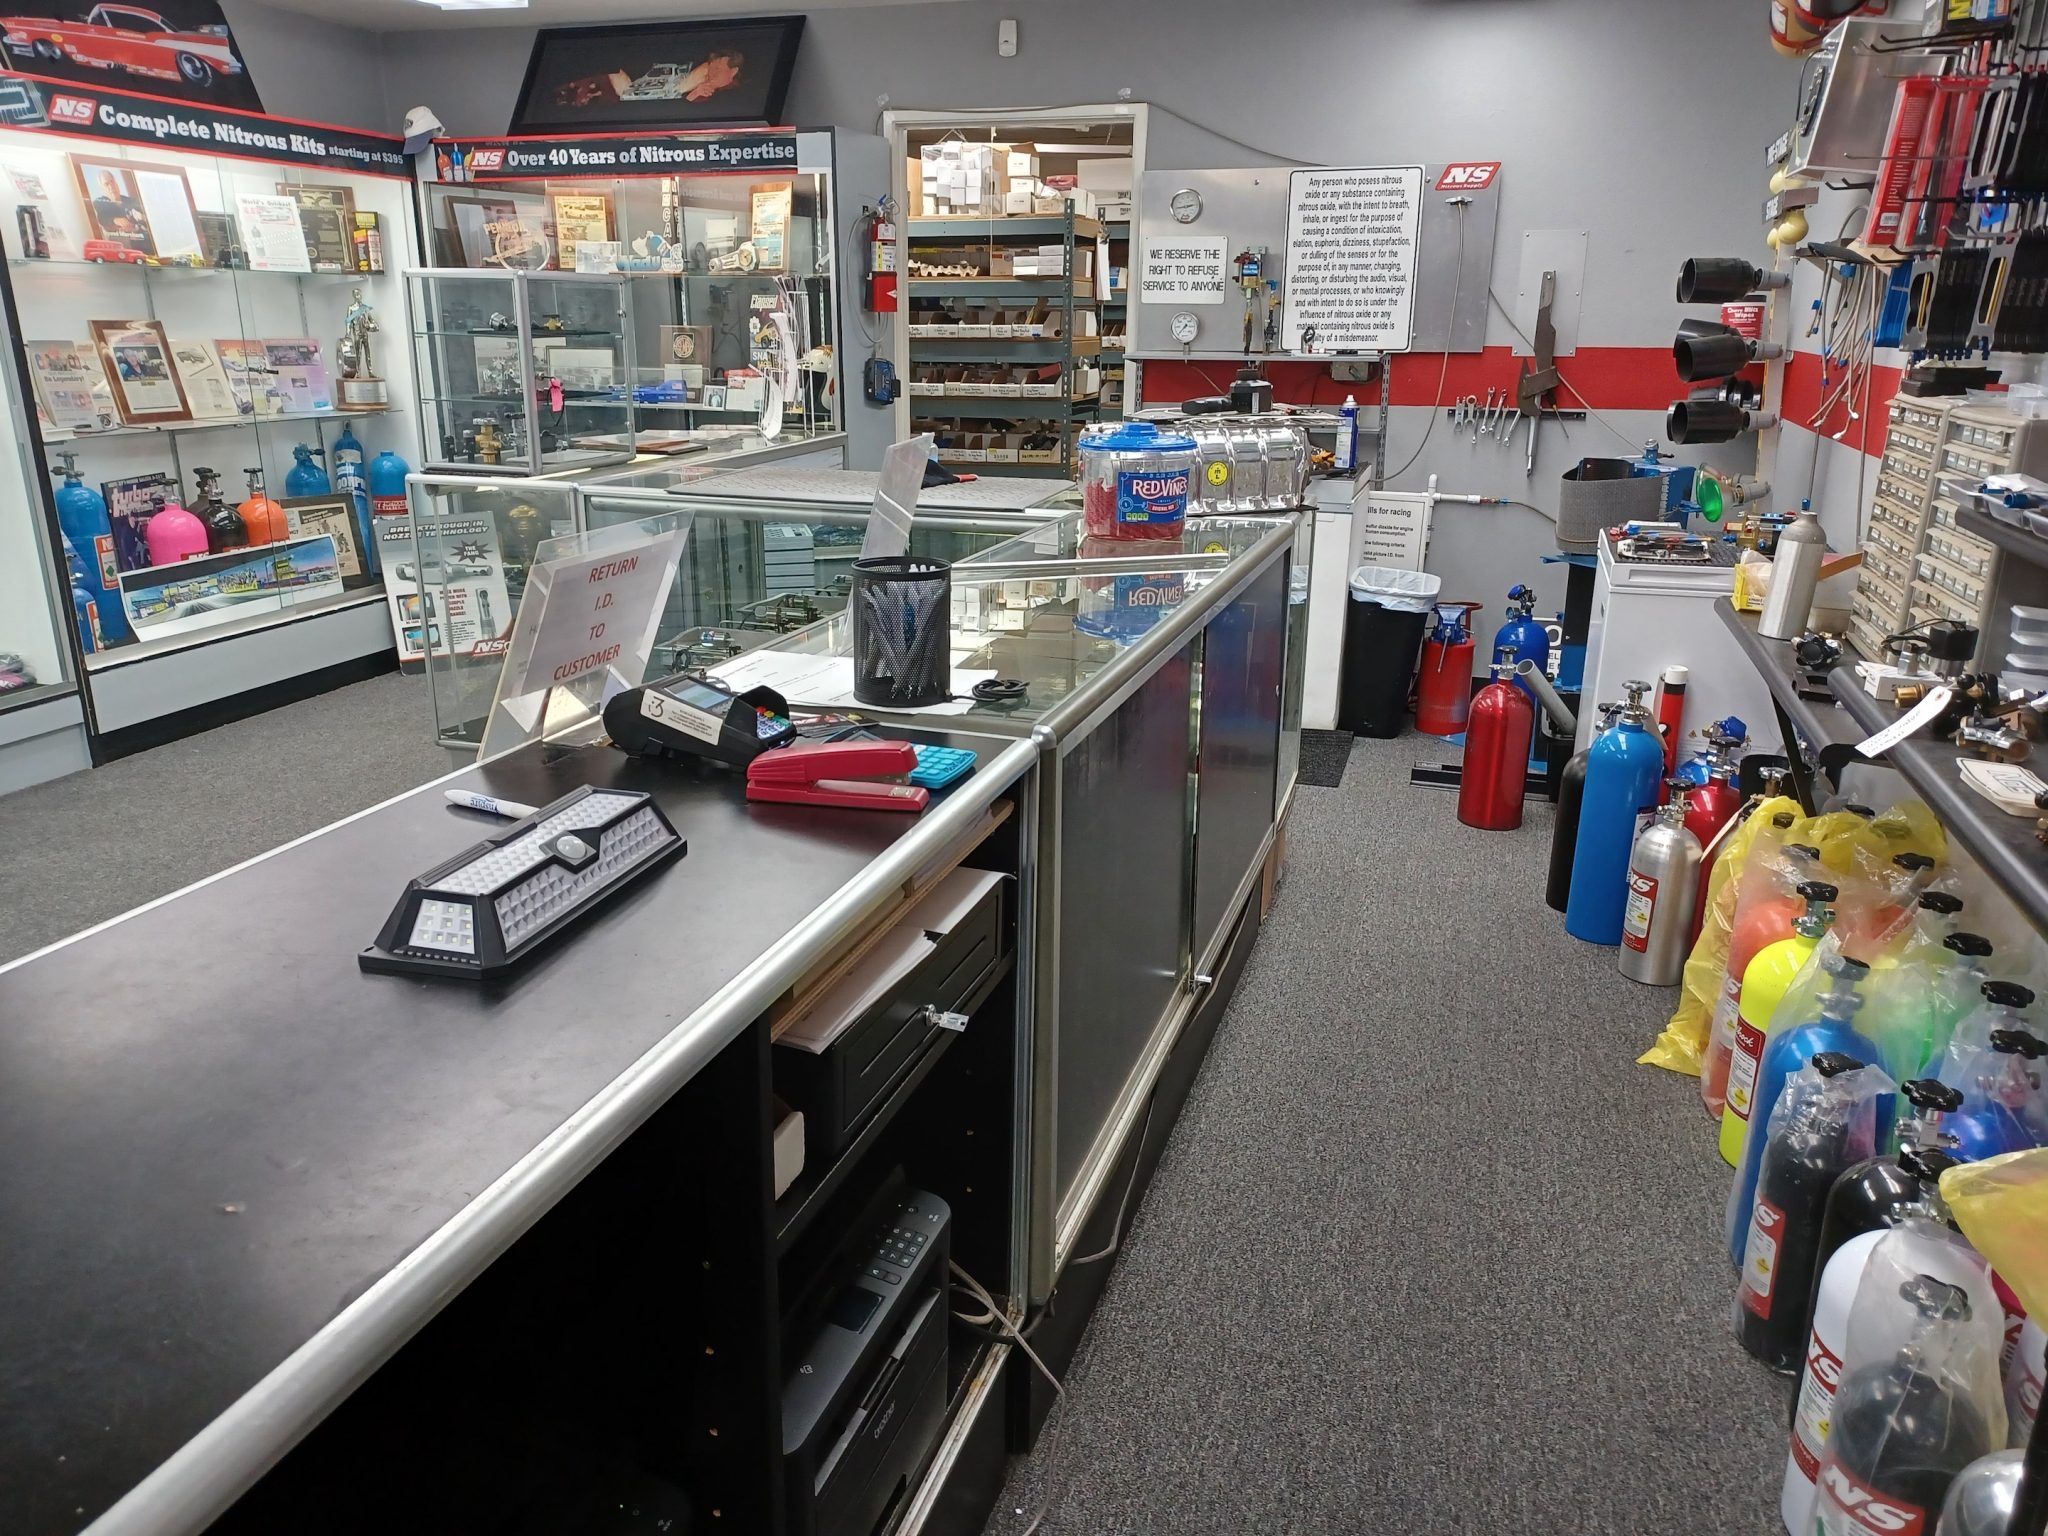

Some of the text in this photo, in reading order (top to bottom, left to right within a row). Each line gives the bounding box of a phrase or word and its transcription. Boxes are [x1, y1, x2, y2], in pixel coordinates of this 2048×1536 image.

[53, 98, 93, 117] NS
[99, 104, 211, 139] Complete
[212, 121, 288, 152] Nitrous
[289, 133, 327, 157] Kits
[328, 145, 370, 164] starting
[371, 152, 382, 163] at
[383, 153, 404, 165] $395
[472, 151, 503, 166] NS
[508, 142, 795, 166] Over 40 Years of Nitrous Expertise
[1442, 165, 1494, 184] NS
[1309, 175, 1402, 188] Any person who posess nitrous
[1305, 190, 1320, 199] oxide
[1330, 191, 1340, 200] any
[1342, 189, 1372, 198] substance
[1374, 188, 1405, 198] containing
[1298, 203, 1318, 211] nitrous
[1338, 201, 1351, 210] with
[1353, 201, 1362, 210] the
[1363, 201, 1380, 210] intent
[1382, 200, 1388, 209] to
[1323, 215, 1328, 223] or
[1330, 214, 1348, 224] ingest
[1349, 213, 1358, 222] for
[1360, 213, 1369, 221] the
[1371, 213, 1395, 224] purpose
[1397, 212, 1403, 221] of
[1302, 226, 1324, 237] causing
[1331, 225, 1358, 235] condition
[1360, 225, 1365, 234] of
[1150, 249, 1220, 259] WE RESERVE THE
[1301, 252, 1307, 260] or
[1309, 251, 1327, 261] dulling
[1329, 251, 1335, 259] of
[1336, 251, 1346, 259] the
[1378, 250, 1387, 258] for
[1388, 249, 1398, 258] the
[1149, 266, 1219, 275] RIGHT TO REFUSE
[1298, 264, 1323, 273] purpose
[1332, 263, 1336, 271] in
[1338, 264, 1348, 273] any
[1321, 275, 1327, 283] or
[1329, 274, 1357, 285] disturbing
[1359, 274, 1368, 282] the
[1143, 281, 1224, 291] SERVICE TO ANYONE
[1300, 287, 1319, 295] mental
[1375, 285, 1405, 296] knowingly
[1295, 299, 1306, 307] and
[1307, 299, 1320, 307] with
[1364, 298, 1369, 306] is
[1370, 298, 1387, 306] under
[1388, 298, 1398, 306] the
[1299, 310, 1325, 319] influence
[1327, 310, 1333, 318] of
[1334, 310, 1354, 318] nitrous
[1356, 310, 1371, 318] oxide
[1381, 310, 1391, 319] any
[1320, 322, 1350, 332] containing
[1351, 322, 1371, 330] nitrous
[1373, 322, 1388, 330] oxide
[1327, 333, 1333, 342] of
[1133, 480, 1163, 499] RED
[1379, 507, 1411, 518] for racing
[389, 521, 469, 533] BREKTHOUGH
[425, 527, 488, 536] TEHNOLOGY
[589, 556, 638, 584] RETURN
[595, 593, 614, 611] I.D.
[589, 623, 605, 641] TO
[475, 641, 506, 653] NS
[553, 643, 621, 681] CUSTOMER
[1823, 1465, 1917, 1530] NS
